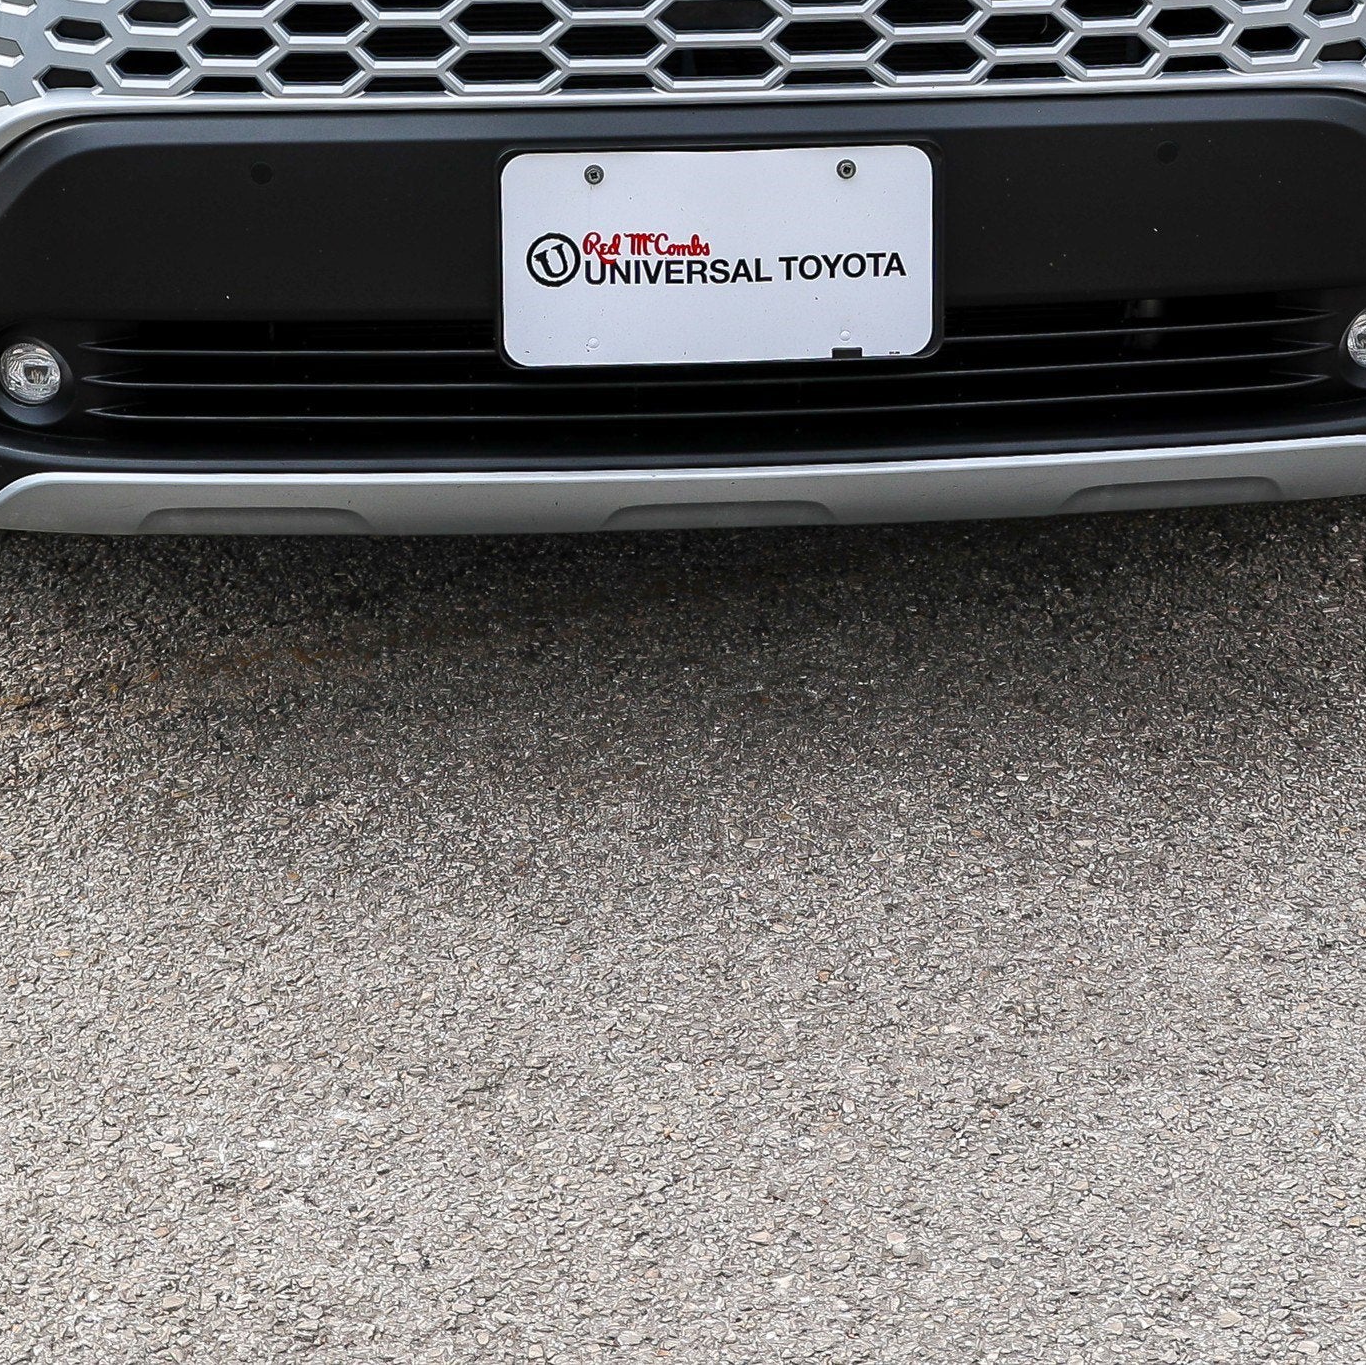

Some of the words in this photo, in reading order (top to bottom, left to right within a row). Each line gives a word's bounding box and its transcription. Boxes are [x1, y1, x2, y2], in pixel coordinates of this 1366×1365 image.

[583, 231, 621, 265] Red
[624, 232, 711, 257] McCombs
[585, 257, 773, 285] UNIVERSAL
[778, 252, 907, 281] TOYOTA
